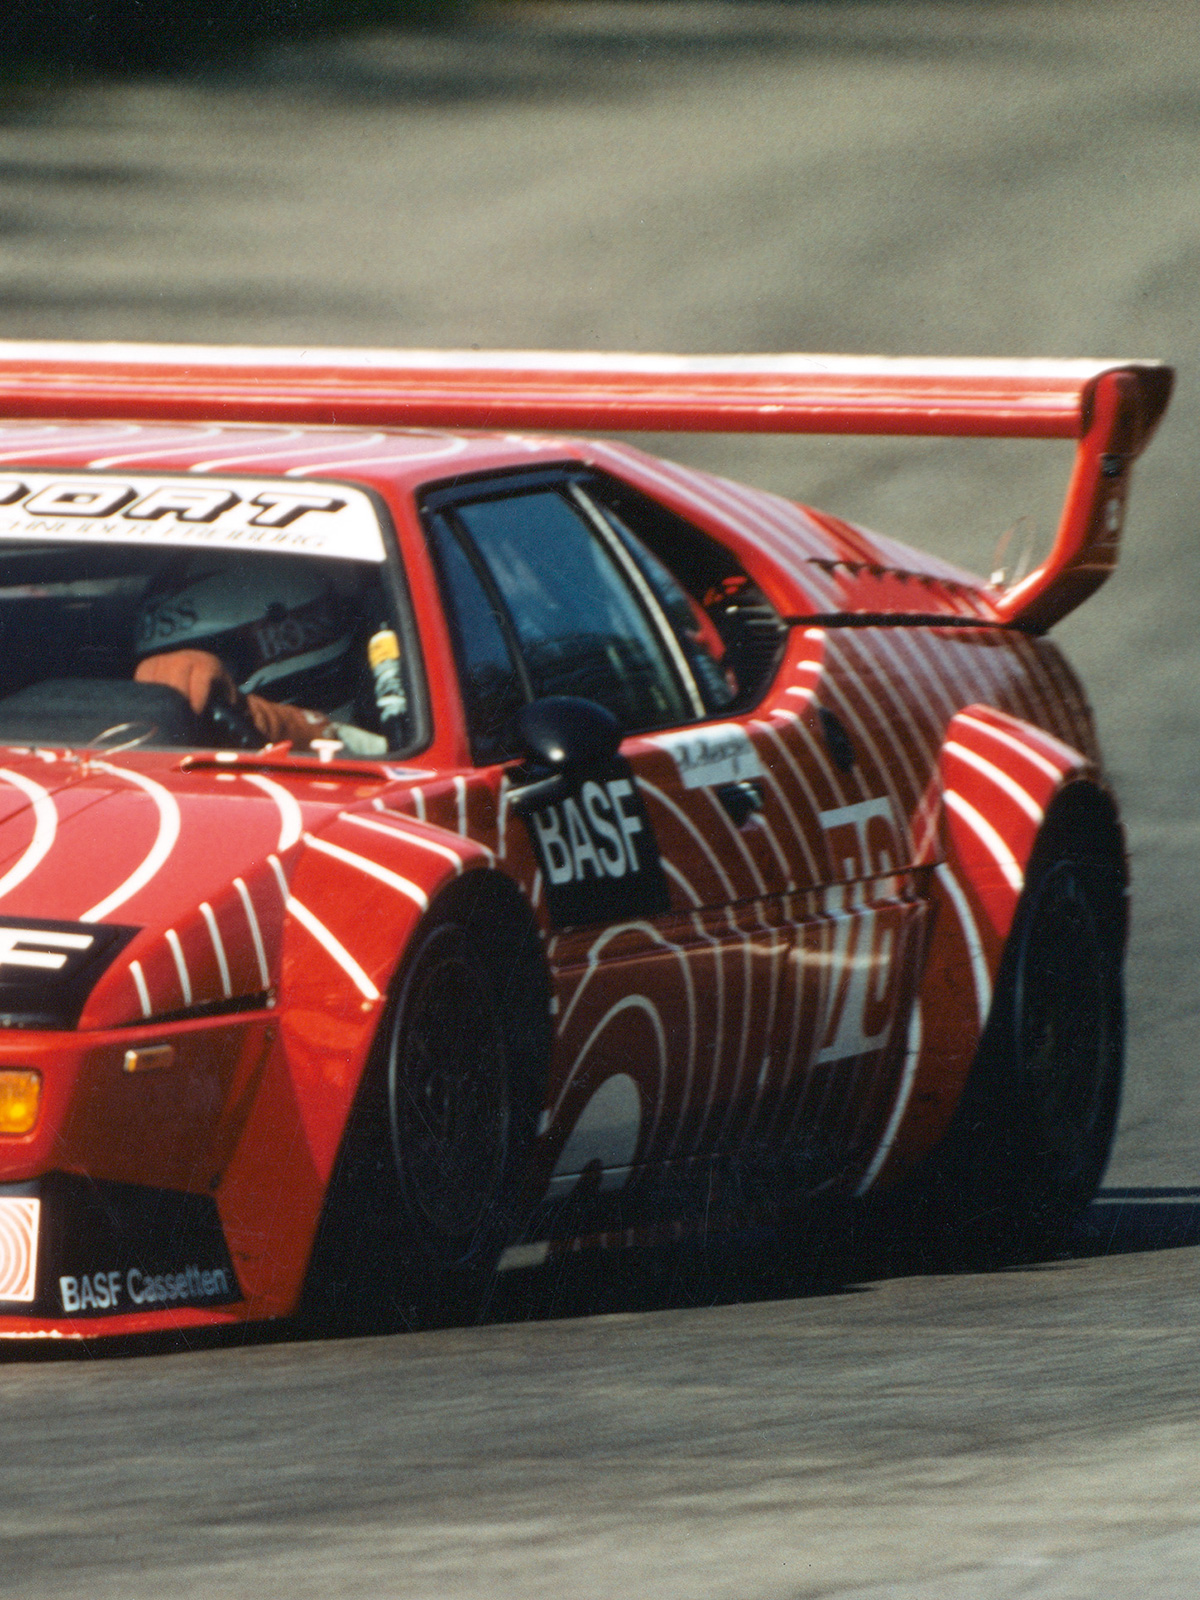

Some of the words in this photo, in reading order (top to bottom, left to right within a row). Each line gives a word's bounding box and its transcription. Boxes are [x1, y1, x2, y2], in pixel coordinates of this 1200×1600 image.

[532, 778, 642, 885] BASF
[60, 1270, 121, 1312] BASF
[127, 1268, 229, 1304] Cassetten
